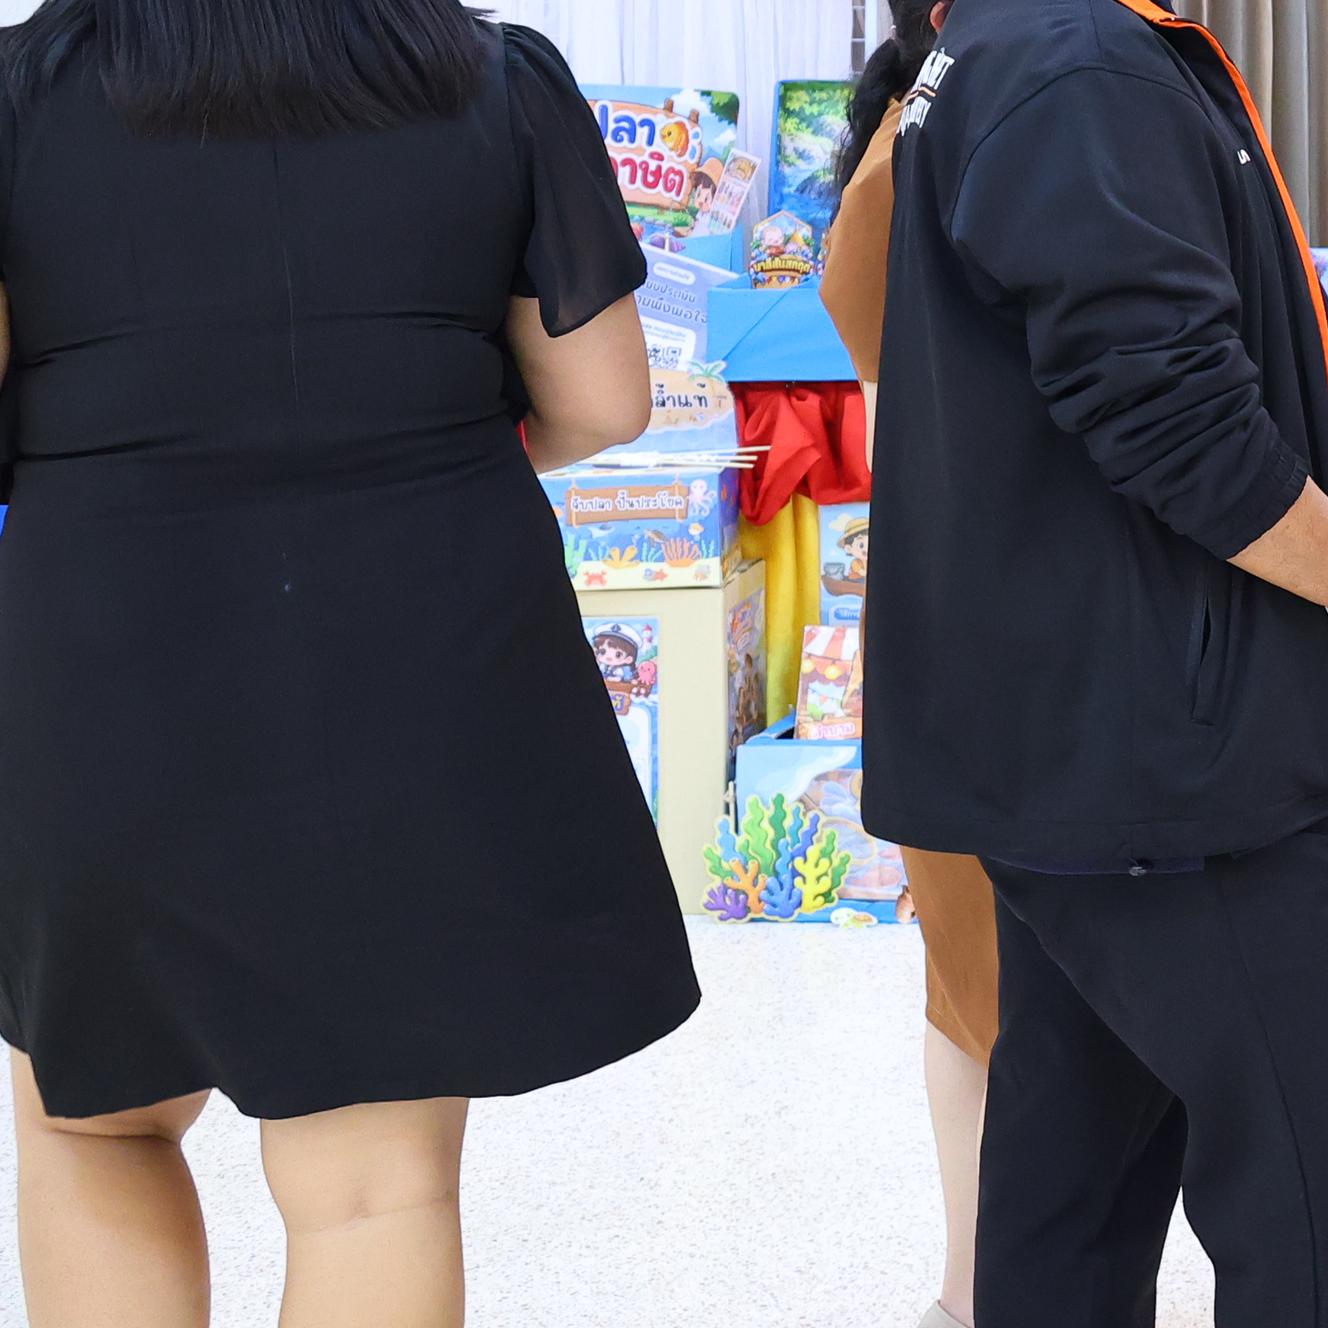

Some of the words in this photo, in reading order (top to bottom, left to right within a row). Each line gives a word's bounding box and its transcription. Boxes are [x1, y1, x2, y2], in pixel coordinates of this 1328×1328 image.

[609, 150, 686, 197] าษิต
[651, 382, 708, 409] ล้ำแท้
